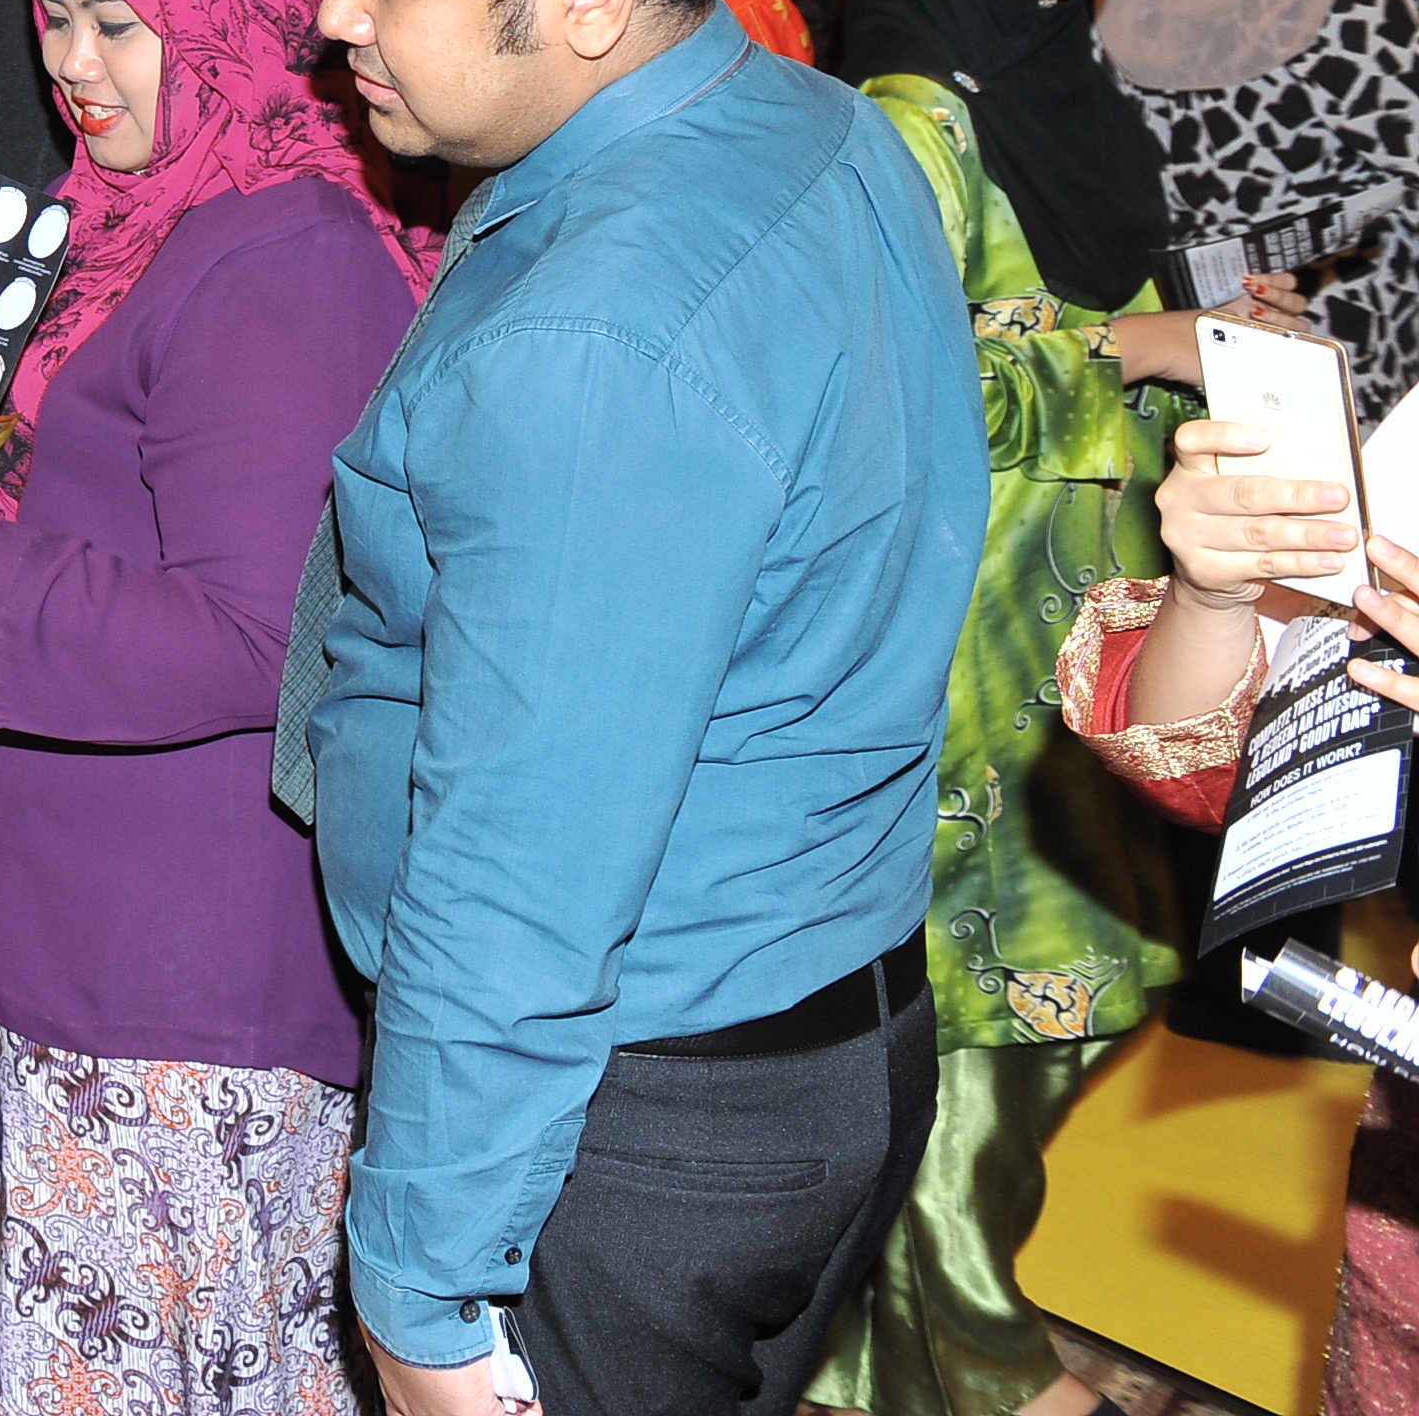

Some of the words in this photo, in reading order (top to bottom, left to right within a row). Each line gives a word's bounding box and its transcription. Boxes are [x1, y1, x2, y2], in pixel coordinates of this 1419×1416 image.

[1293, 683, 1325, 718] THESE
[1297, 709, 1315, 736] AN
[1299, 717, 1342, 754] GOODY
[1249, 785, 1273, 809] HOW
[1272, 766, 1301, 793] DOES
[1302, 760, 1316, 777] IT
[1316, 741, 1364, 770] WORK?
